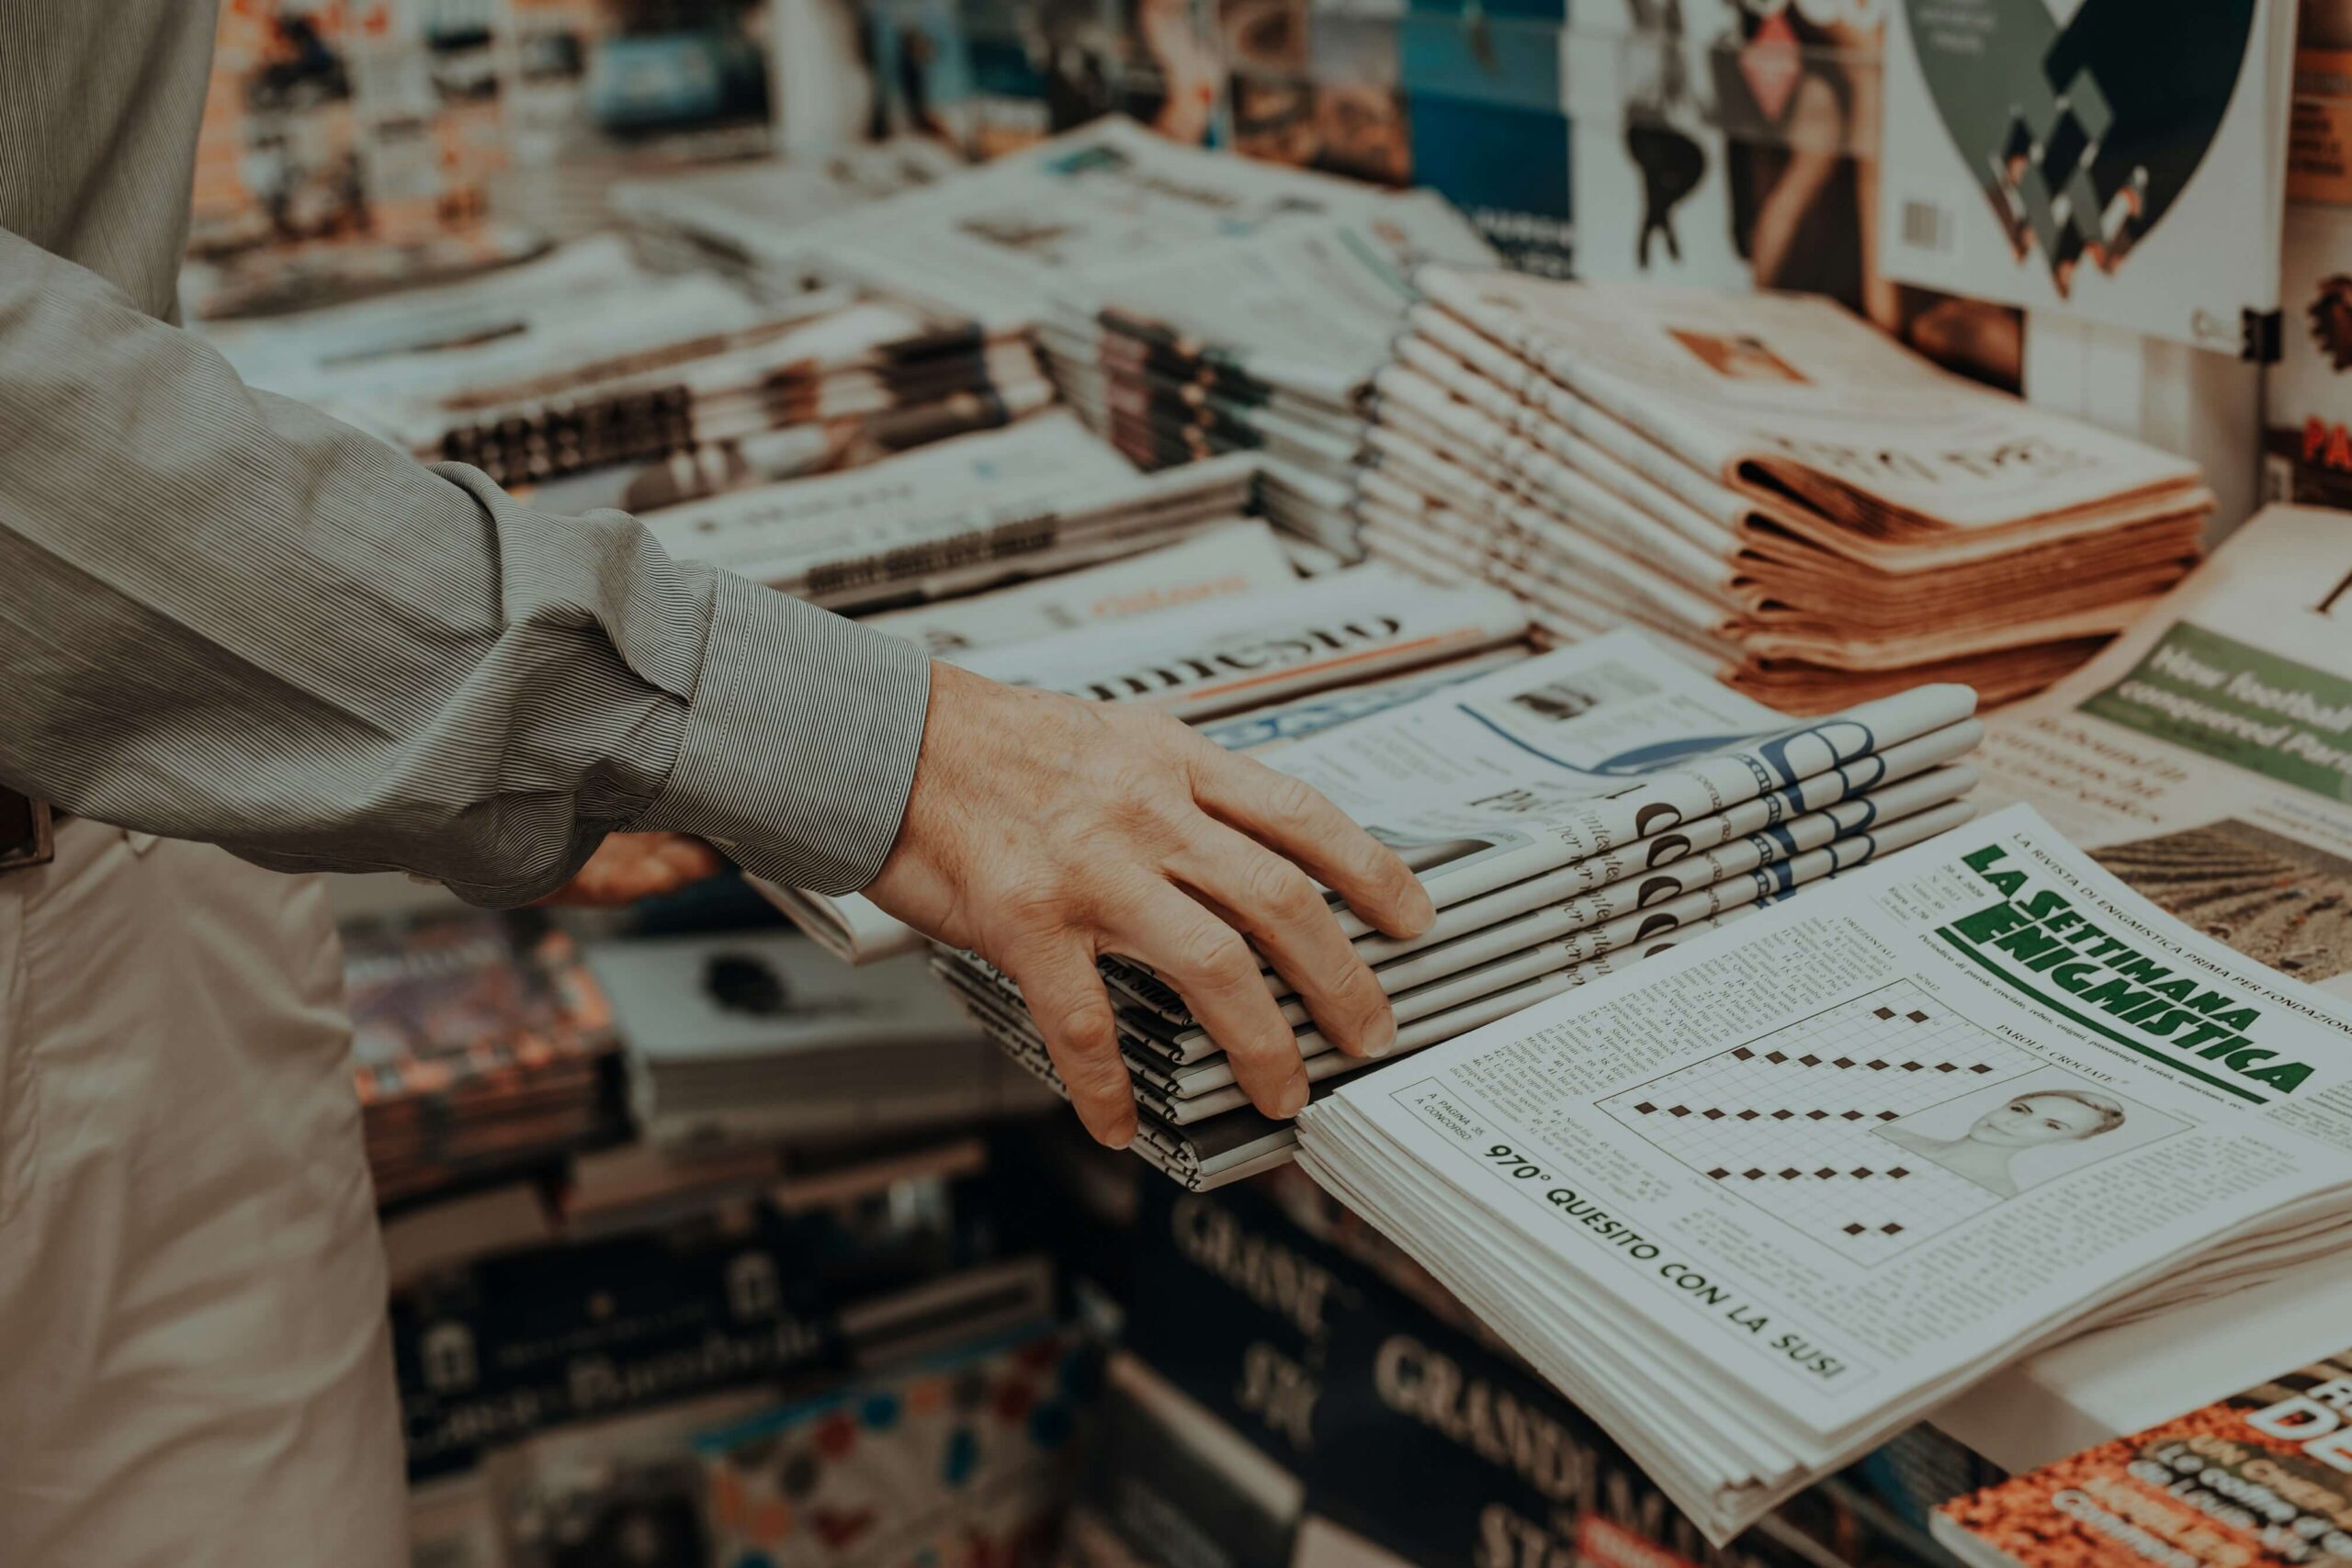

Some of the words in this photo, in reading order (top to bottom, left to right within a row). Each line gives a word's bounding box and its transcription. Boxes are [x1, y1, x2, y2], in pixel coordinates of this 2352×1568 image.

[1951, 900, 2316, 1094] ENIGMISTICA
[1961, 843, 2030, 898] LA
[2018, 889, 2261, 1032] SETTIMANA
[2014, 832, 2031, 848] LA
[2032, 846, 2079, 892] RIVISTA
[2080, 885, 2098, 902] DI
[2097, 896, 2183, 955] ENIGMISTICA
[2184, 950, 2230, 977] PRIMA
[2232, 976, 2261, 992] PER
[1438, 1100, 1470, 1124] PAGINA
[1996, 1024, 2042, 1049] PAROLE
[2049, 1052, 2111, 1080] CROCIATE
[1546, 1189, 1659, 1258] QUESITO
[1660, 1263, 1729, 1304] CON
[1726, 1305, 1768, 1333] LA
[1770, 1334, 1844, 1377] SUSI
